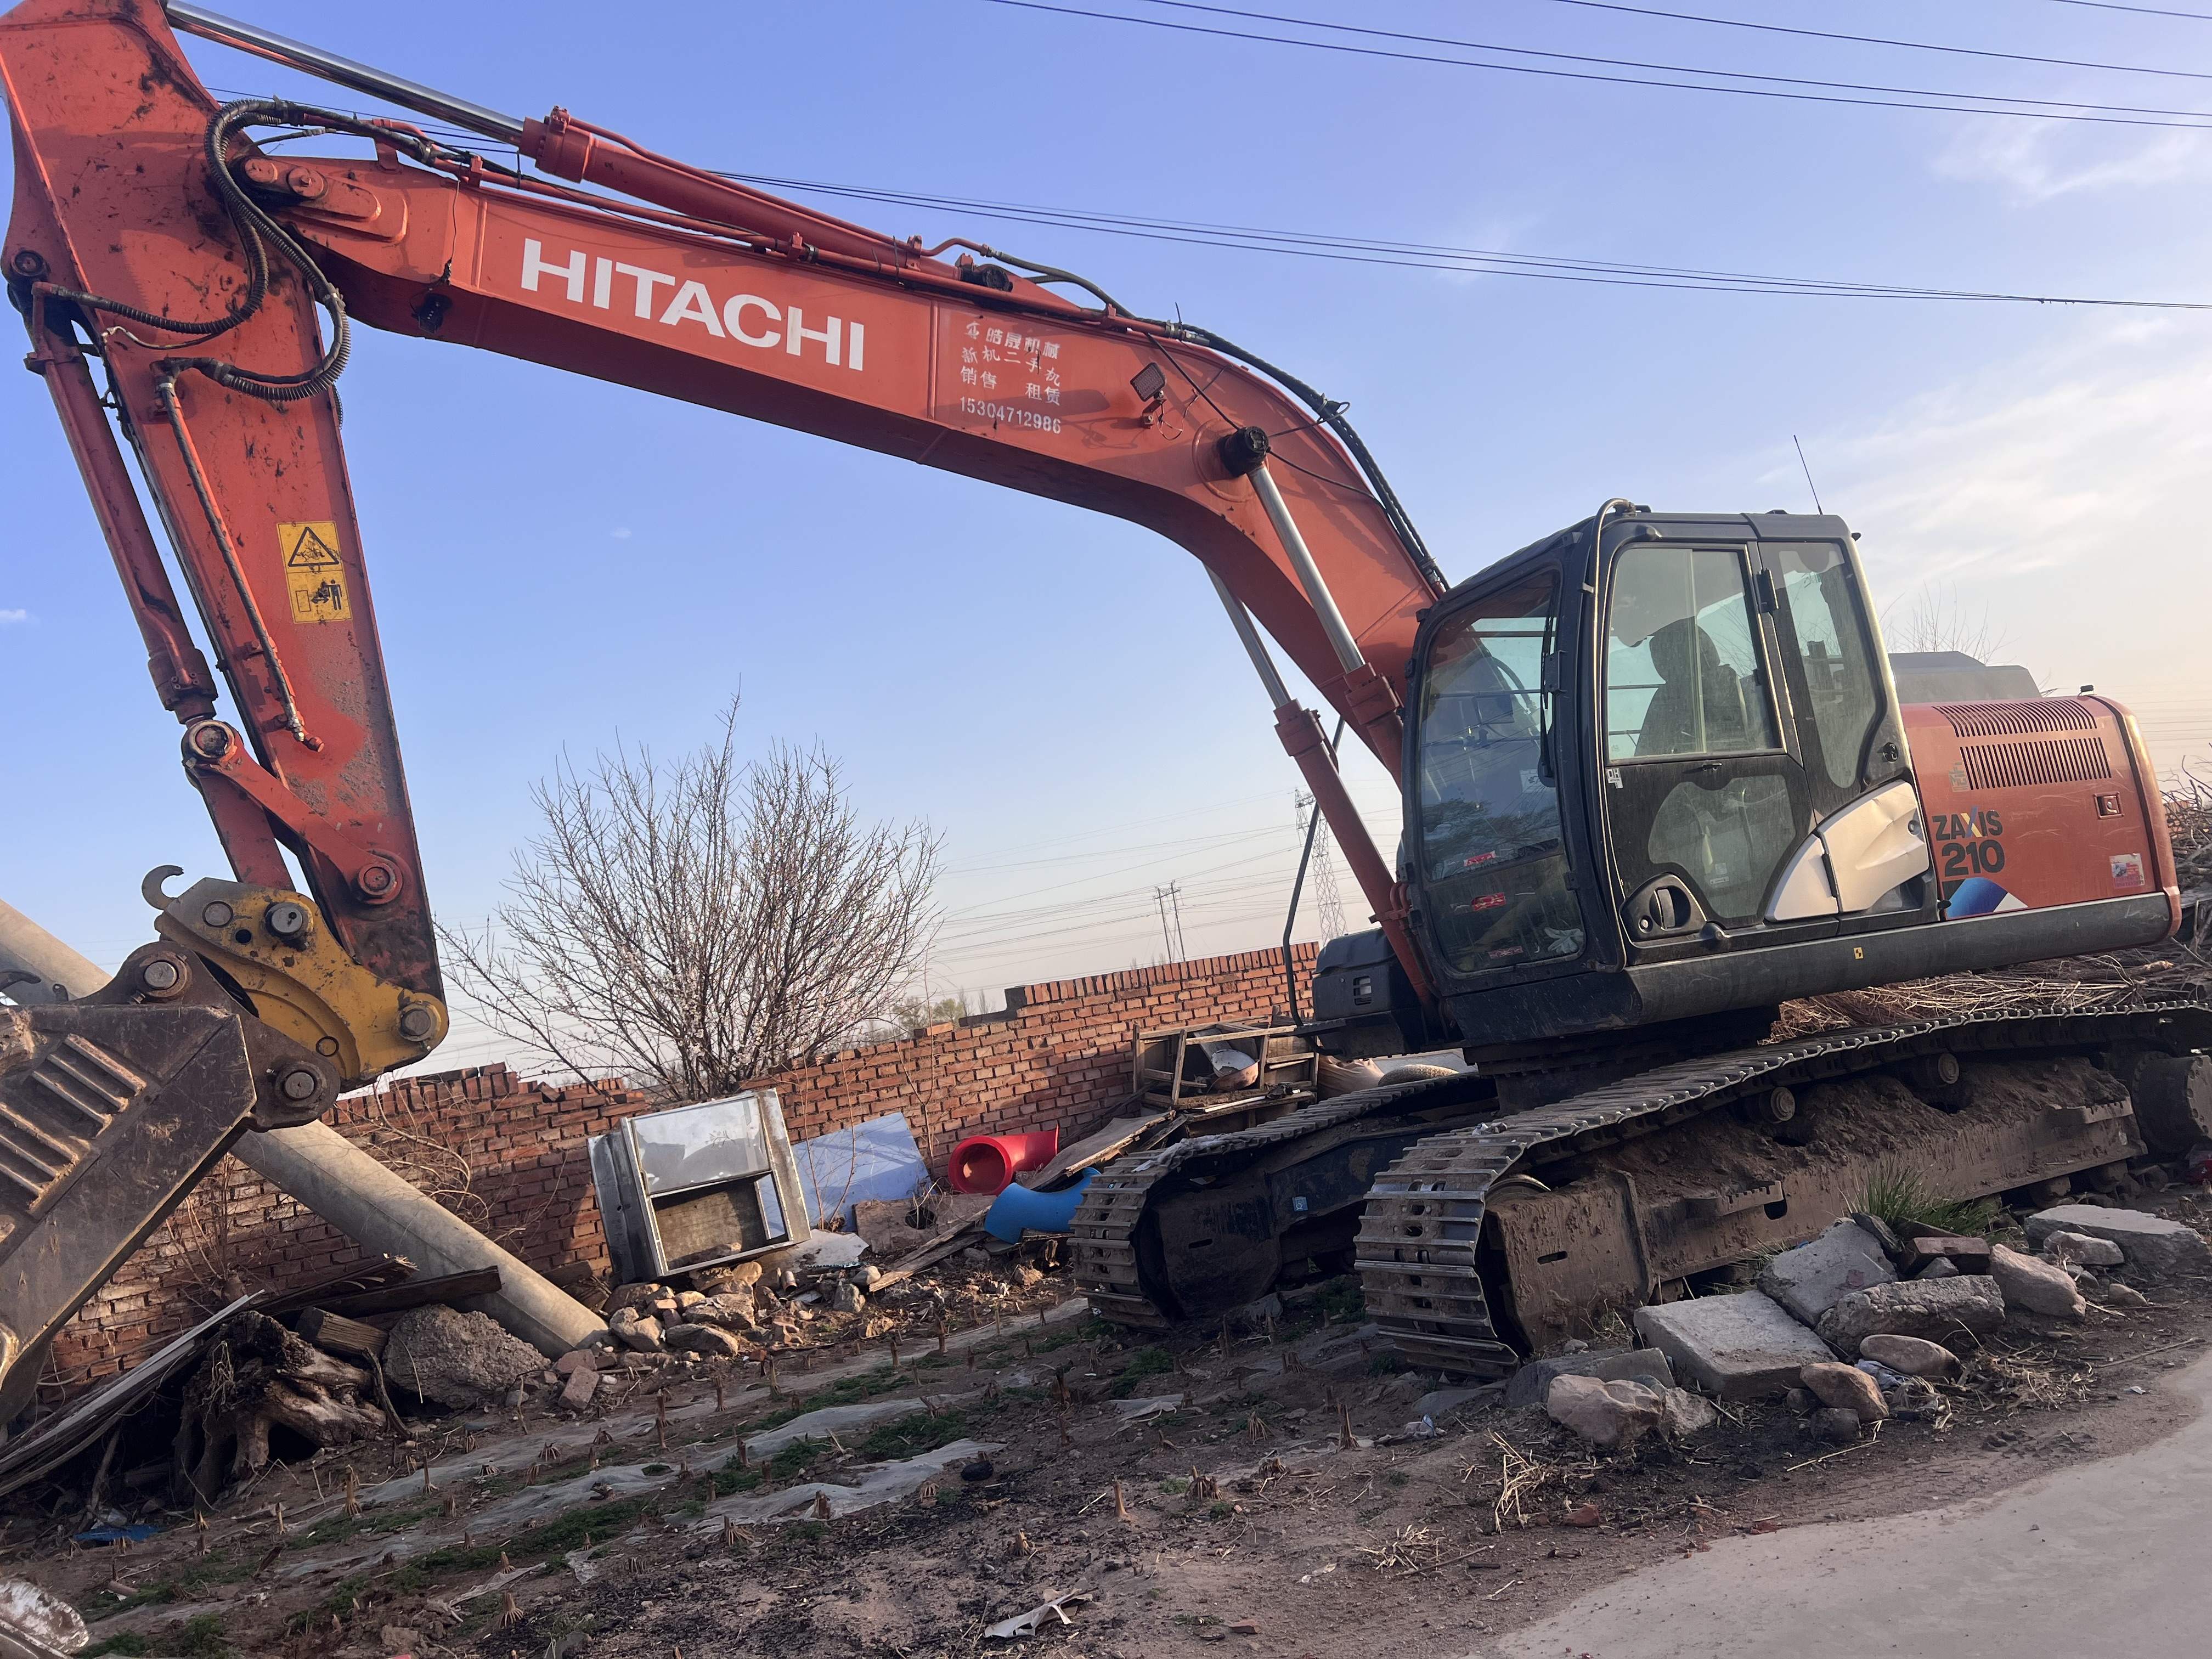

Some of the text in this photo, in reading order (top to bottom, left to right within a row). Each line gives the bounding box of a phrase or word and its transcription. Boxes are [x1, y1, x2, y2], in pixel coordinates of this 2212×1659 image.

[521, 238, 864, 371] HITACHI
[961, 366, 1060, 406] 销售 租赁
[961, 397, 1062, 434] 15304712986
[1932, 806, 2003, 841] ZAXIS
[1942, 839, 2005, 877] 210
